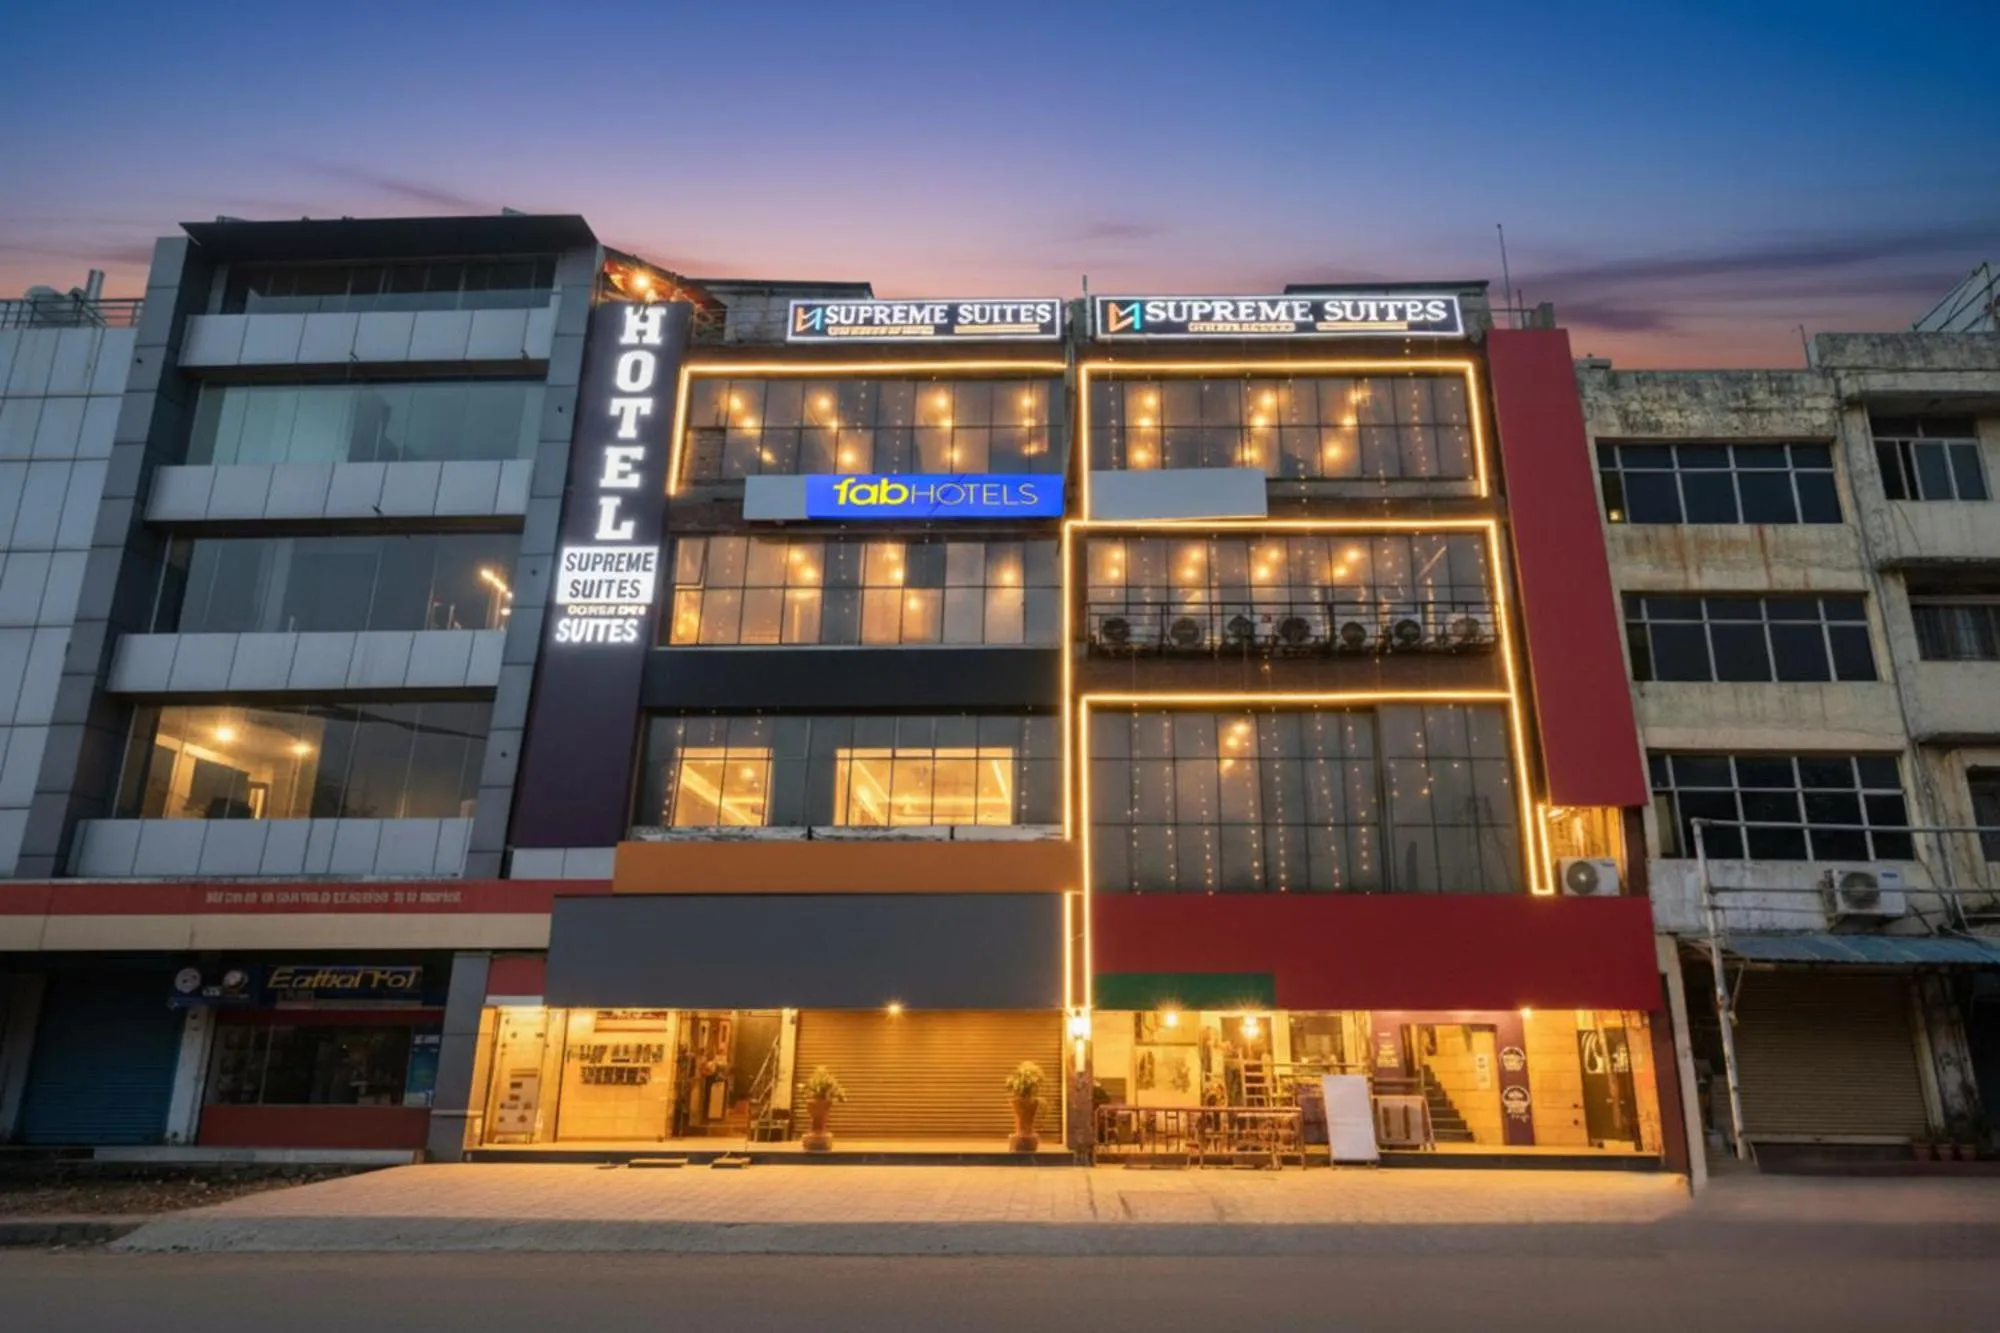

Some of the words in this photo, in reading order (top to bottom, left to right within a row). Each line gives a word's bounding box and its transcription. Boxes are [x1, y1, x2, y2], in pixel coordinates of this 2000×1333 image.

[824, 304, 948, 325] SUPREME
[957, 304, 1052, 323] SUITES
[1144, 300, 1313, 323] SUPREME
[1324, 300, 1448, 321] SUITES
[594, 306, 667, 541] HOTEL
[565, 552, 654, 573] SUPREME
[569, 579, 641, 599] SUITES
[555, 617, 639, 643] SUITES
